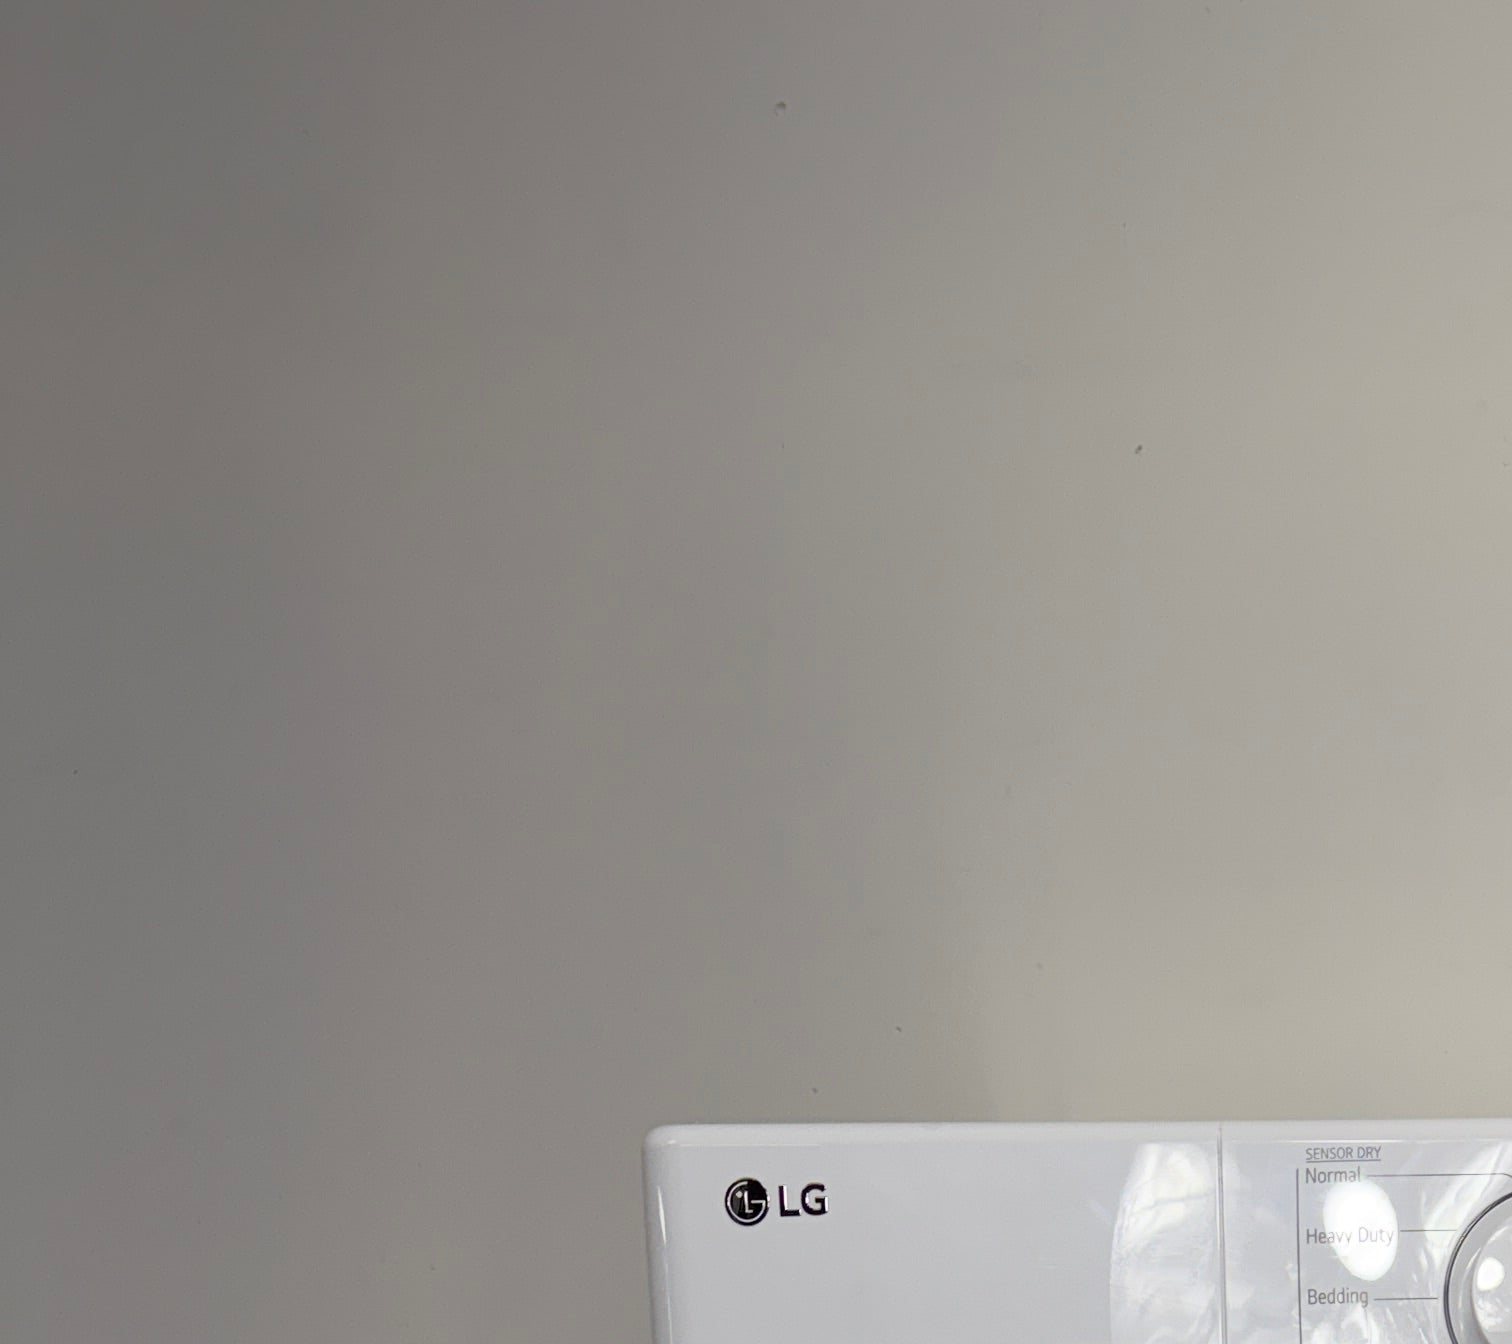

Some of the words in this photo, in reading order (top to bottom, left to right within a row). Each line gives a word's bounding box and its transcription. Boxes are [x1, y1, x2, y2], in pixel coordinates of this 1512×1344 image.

[1305, 1146, 1353, 1160] SENSOR
[1357, 1146, 1381, 1158] DRY
[1305, 1166, 1360, 1184] Normal
[778, 1183, 829, 1217] LG
[1306, 1228, 1353, 1245] Heavy
[1358, 1226, 1394, 1247] Duty
[1307, 1288, 1369, 1308] Bedding
